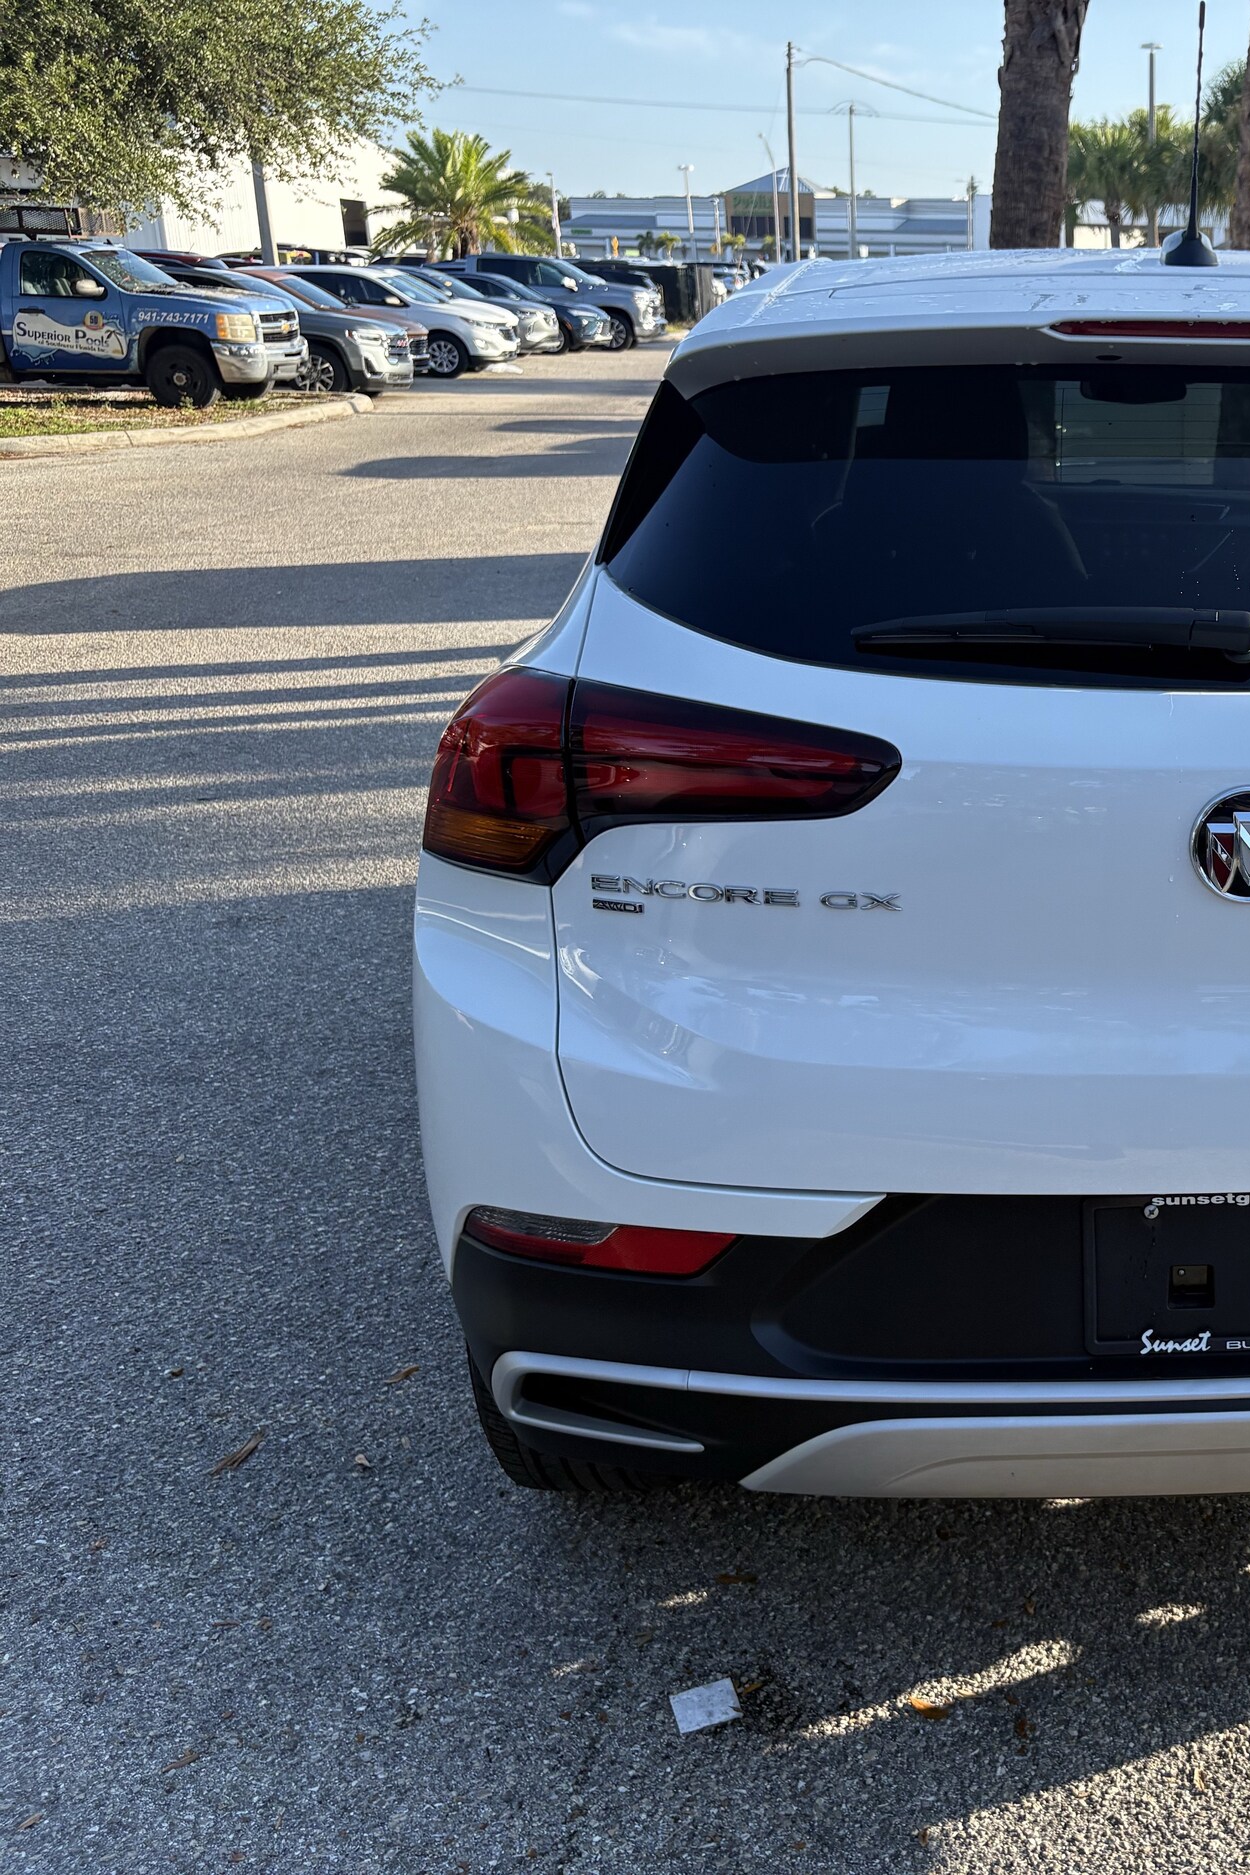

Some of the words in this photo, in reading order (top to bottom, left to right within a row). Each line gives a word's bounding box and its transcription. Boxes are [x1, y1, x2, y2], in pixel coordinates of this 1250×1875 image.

[138, 311, 209, 324] 941-743-7171
[591, 873, 800, 907] ENCORE
[820, 891, 904, 911] GX
[1140, 1329, 1212, 1355] Sunset
